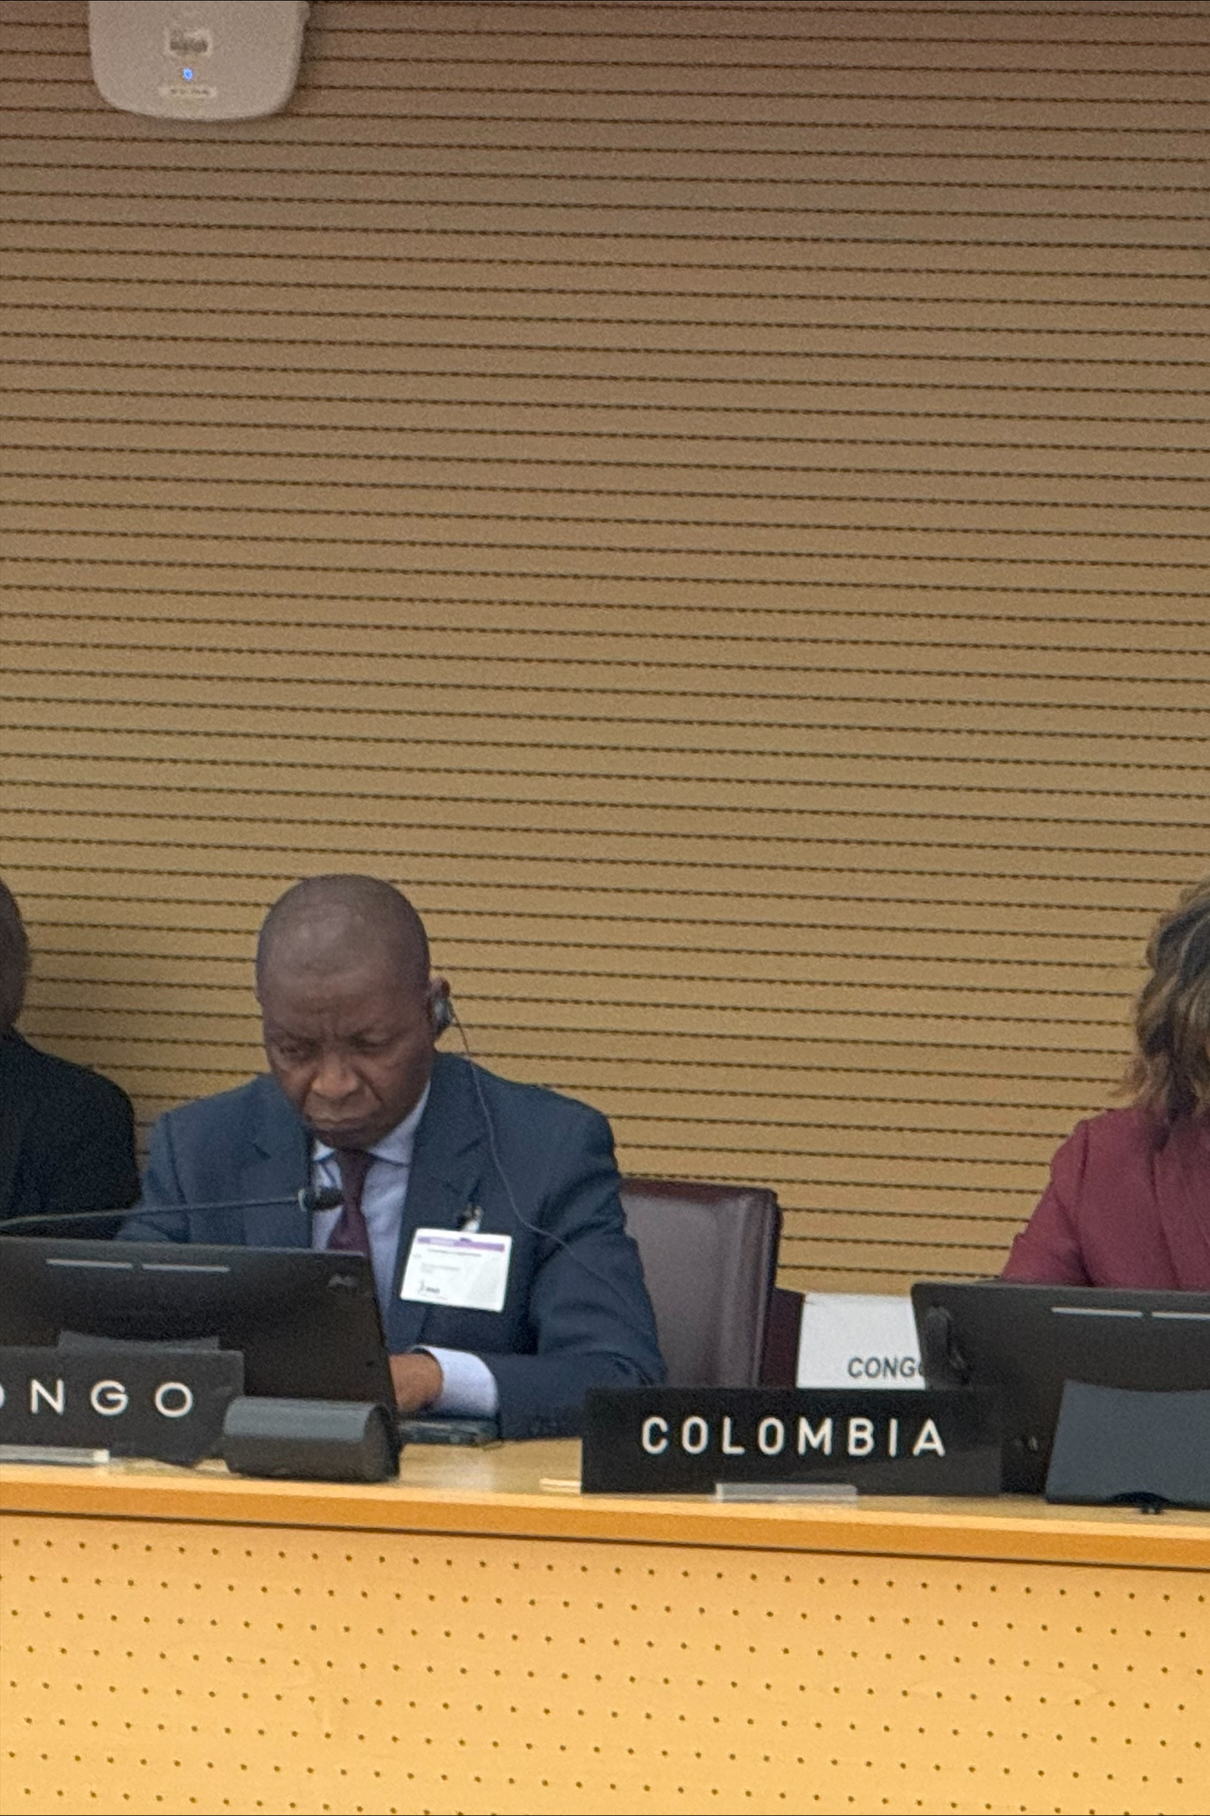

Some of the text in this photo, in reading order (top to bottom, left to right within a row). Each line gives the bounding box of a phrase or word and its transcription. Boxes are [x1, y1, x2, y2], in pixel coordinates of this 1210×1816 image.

[847, 1356, 924, 1379] CONG
[0, 1379, 194, 1418] NGO
[641, 1415, 945, 1458] COLOMBIA
